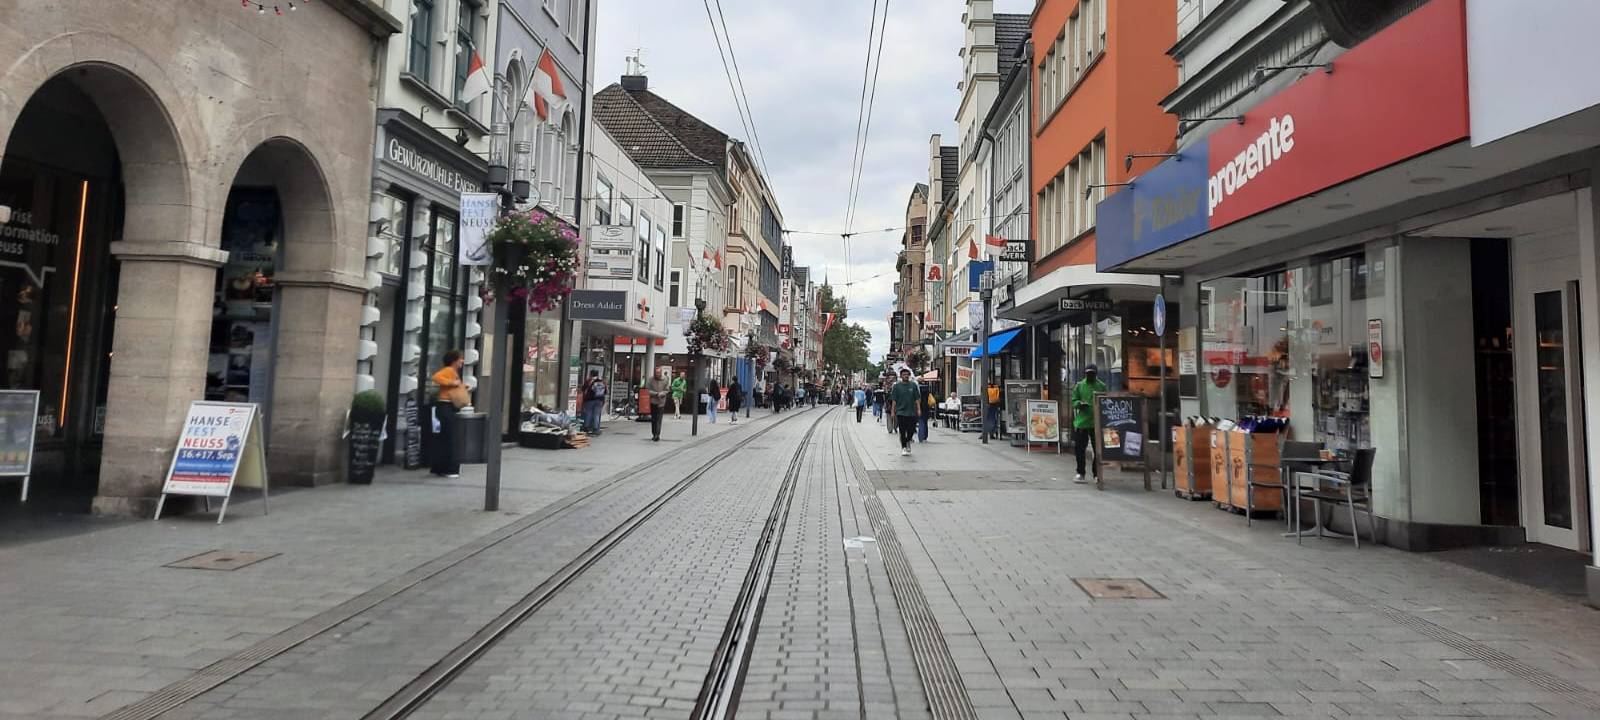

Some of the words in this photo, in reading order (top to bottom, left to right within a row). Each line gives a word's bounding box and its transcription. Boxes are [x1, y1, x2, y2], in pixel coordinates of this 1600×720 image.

[1208, 113, 1295, 217] prozente
[461, 199, 496, 208] HANSE
[12, 210, 32, 224] rist
[461, 208, 485, 218] FEST
[781, 280, 789, 312] HEMA
[573, 300, 595, 309] Dress
[596, 301, 623, 310] Addict
[190, 416, 231, 427] HANSE
[186, 426, 217, 437] FEST
[183, 437, 225, 449] NEUSS
